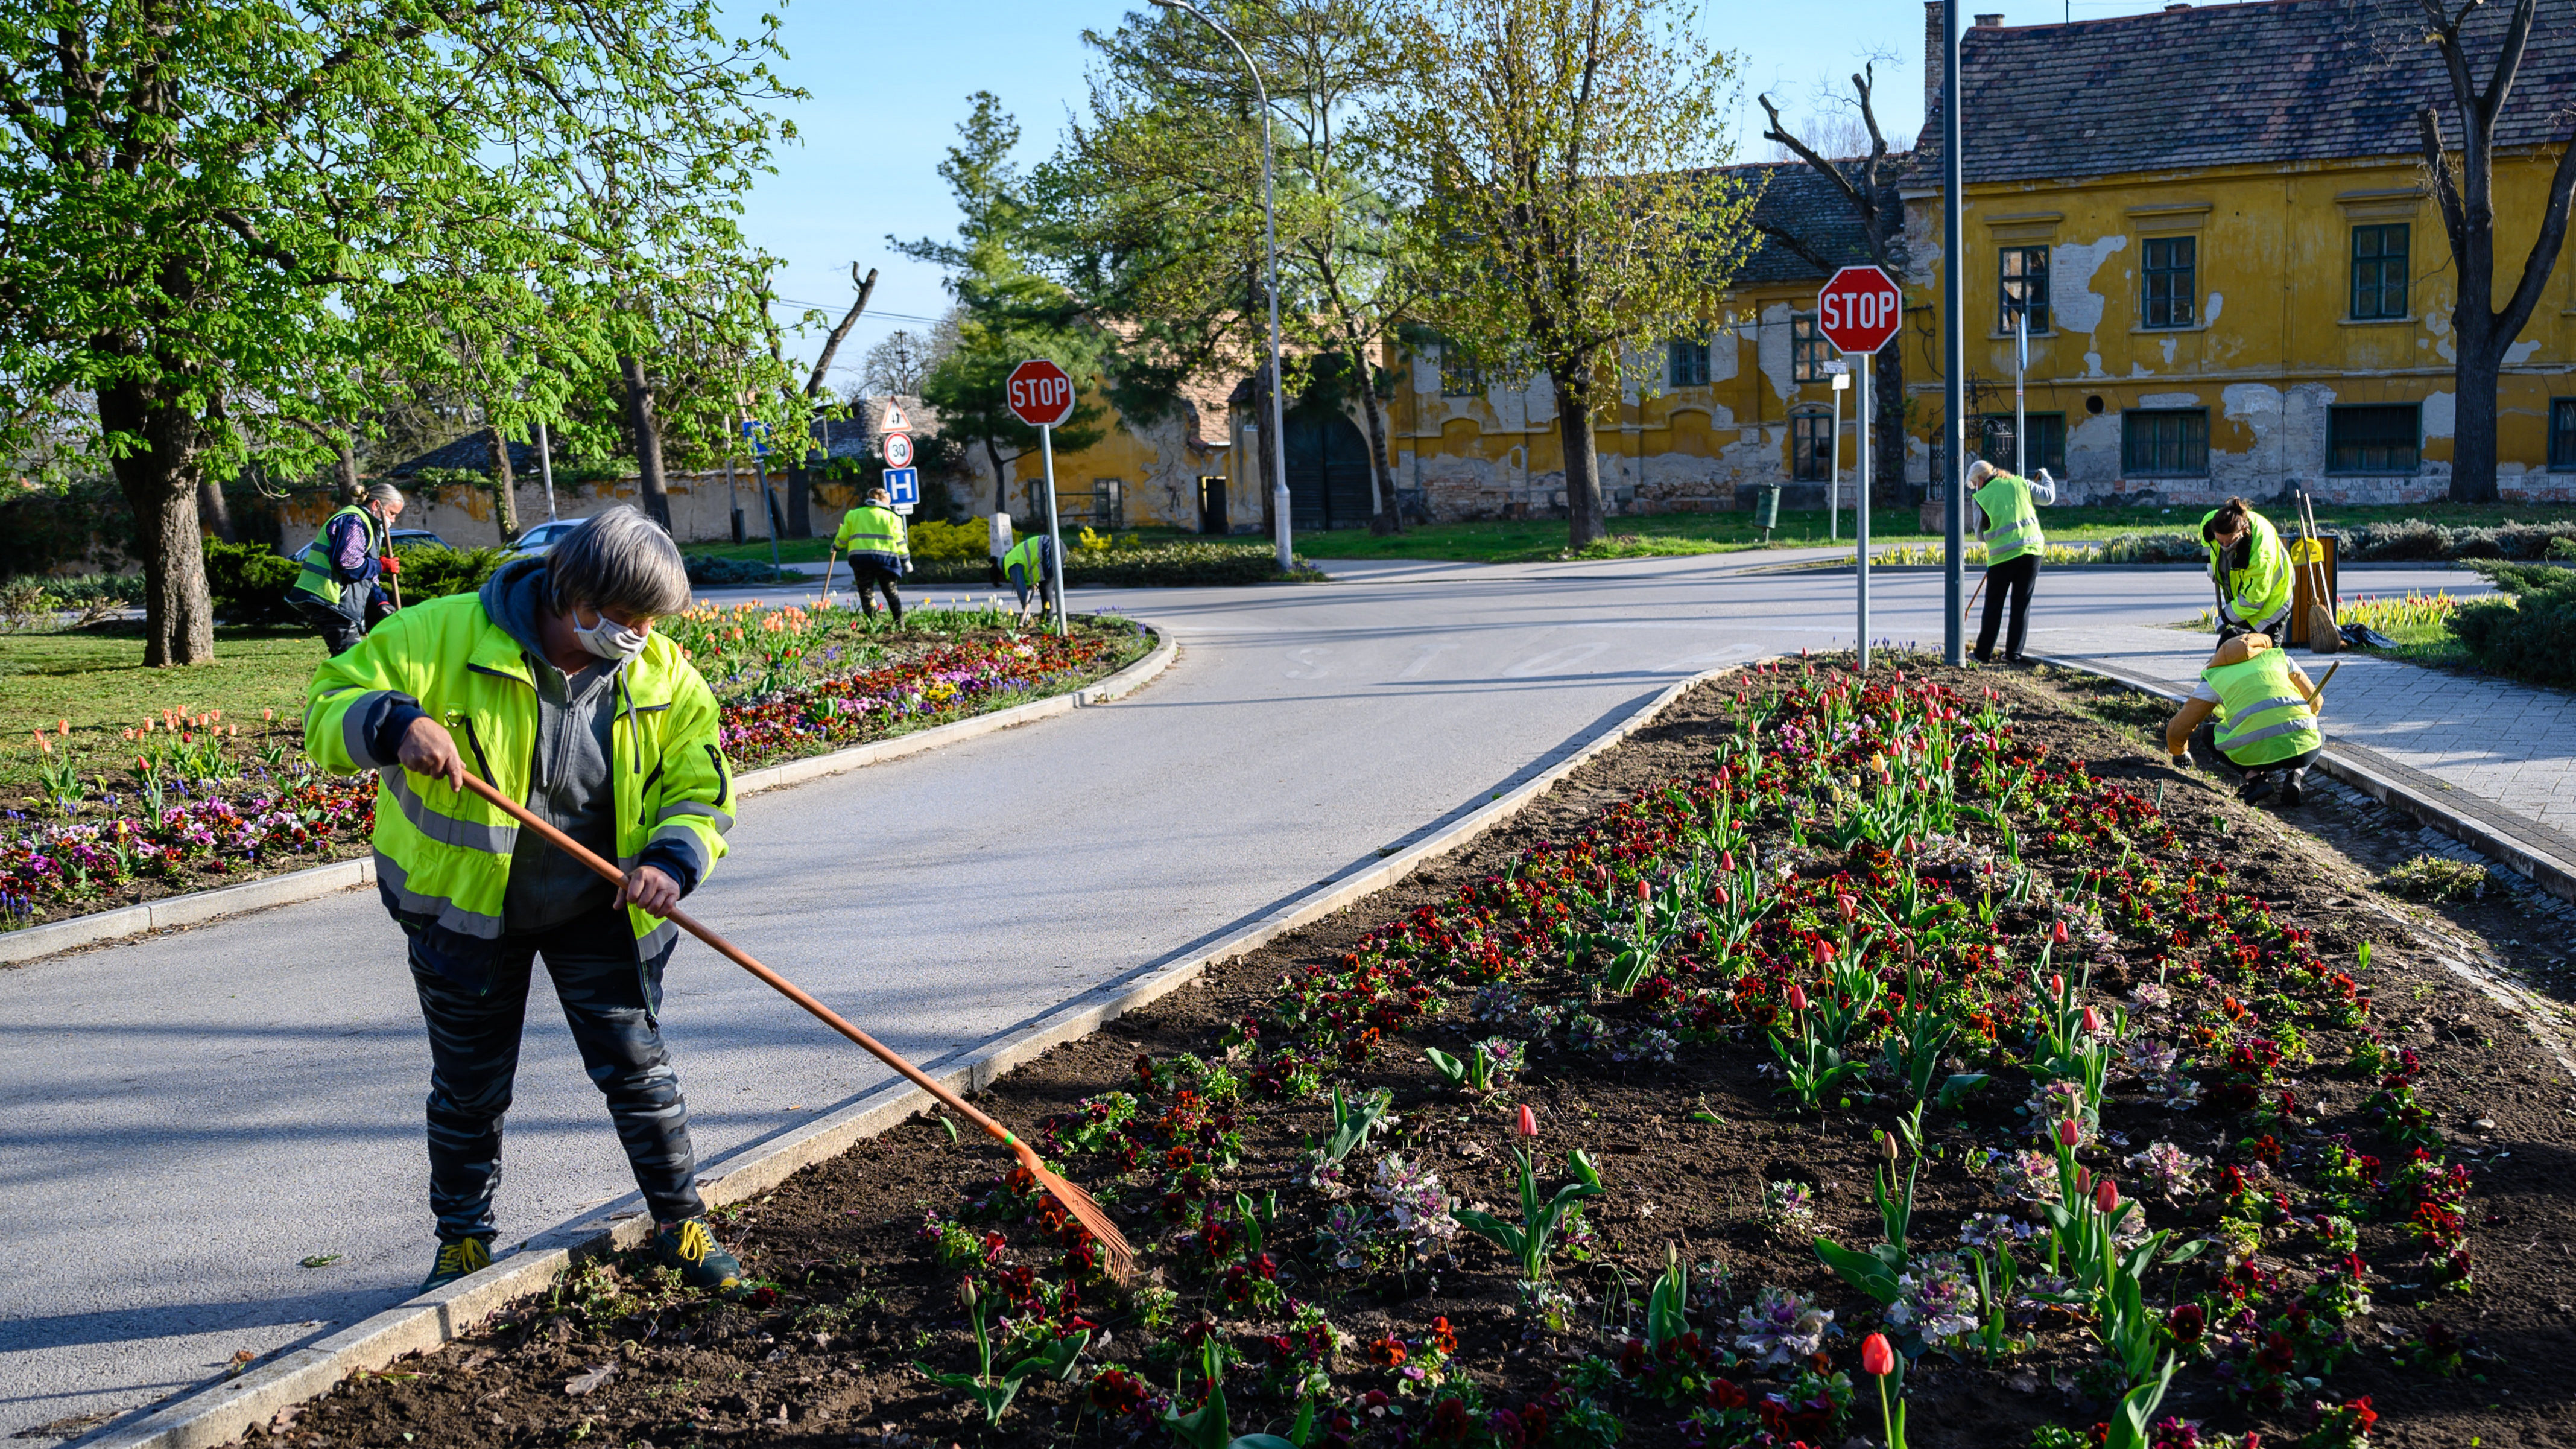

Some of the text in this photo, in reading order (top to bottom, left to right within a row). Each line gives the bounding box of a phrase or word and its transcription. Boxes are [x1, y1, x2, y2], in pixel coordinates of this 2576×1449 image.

[1824, 291, 1894, 330] STOP
[1012, 378, 1067, 407] STOP
[893, 444, 905, 457] 30
[890, 473, 913, 501] H
